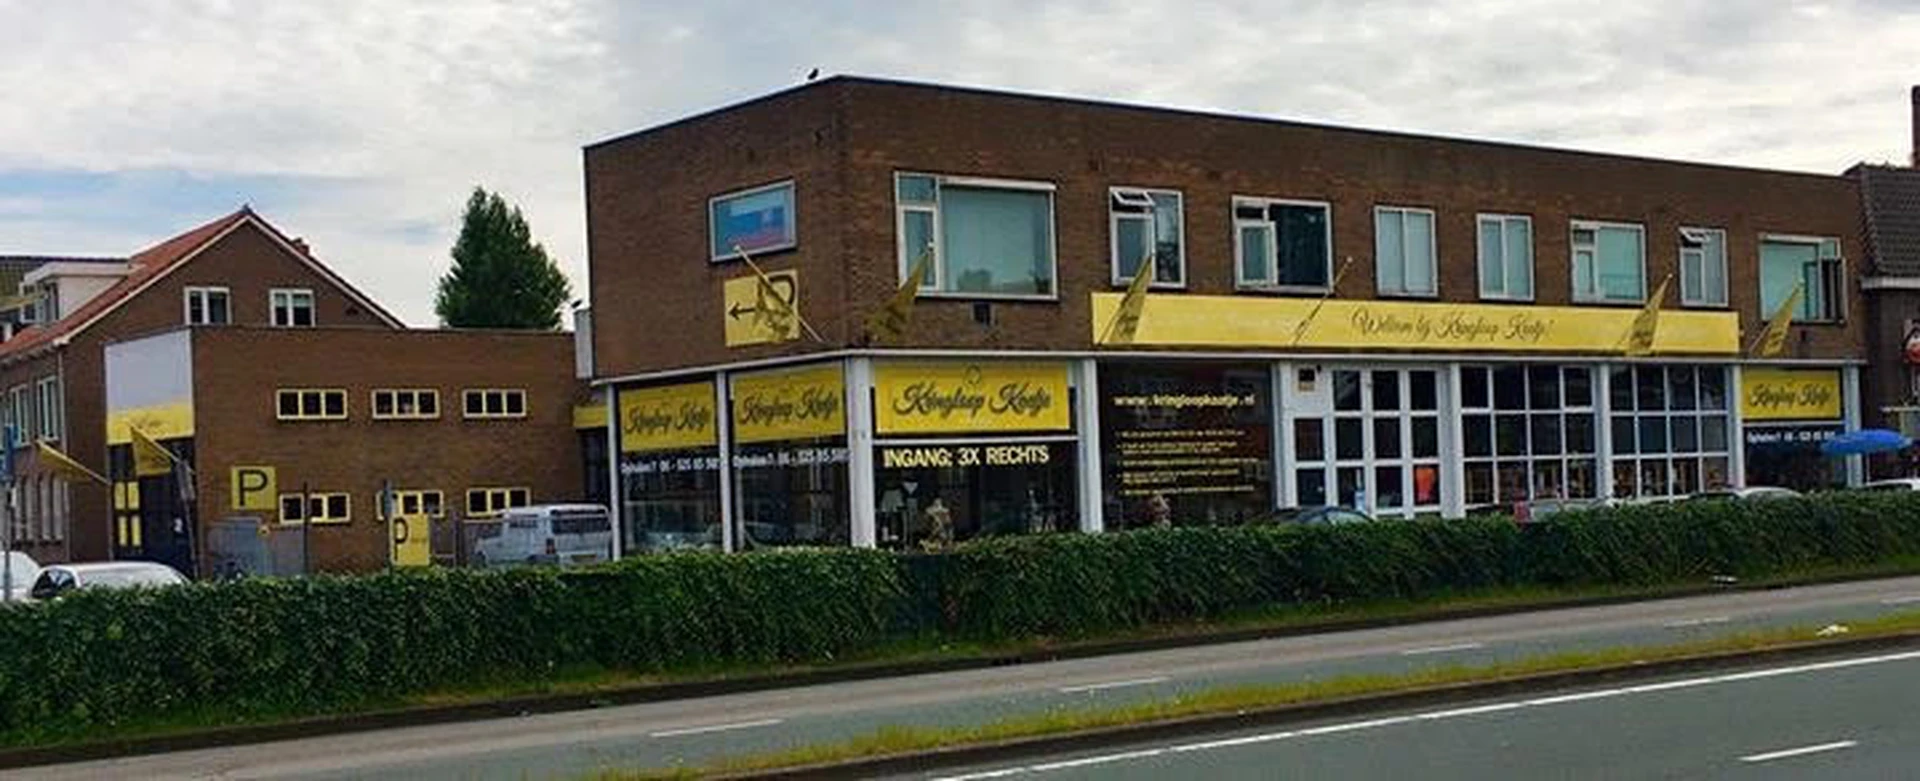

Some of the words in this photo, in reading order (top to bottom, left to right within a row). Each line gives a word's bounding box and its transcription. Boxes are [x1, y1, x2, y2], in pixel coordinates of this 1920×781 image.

[738, 394, 794, 427] Kringloop
[892, 381, 985, 418] Kringloop
[988, 381, 1052, 417] Kaatje
[1113, 393, 1255, 409] www.kringloopkaatje.nl
[623, 405, 673, 434] Kringloop
[883, 447, 953, 470] INGANG:
[957, 447, 980, 466] 3X
[985, 444, 1049, 466] RECHTS
[238, 469, 268, 507] P
[393, 517, 409, 562] P
